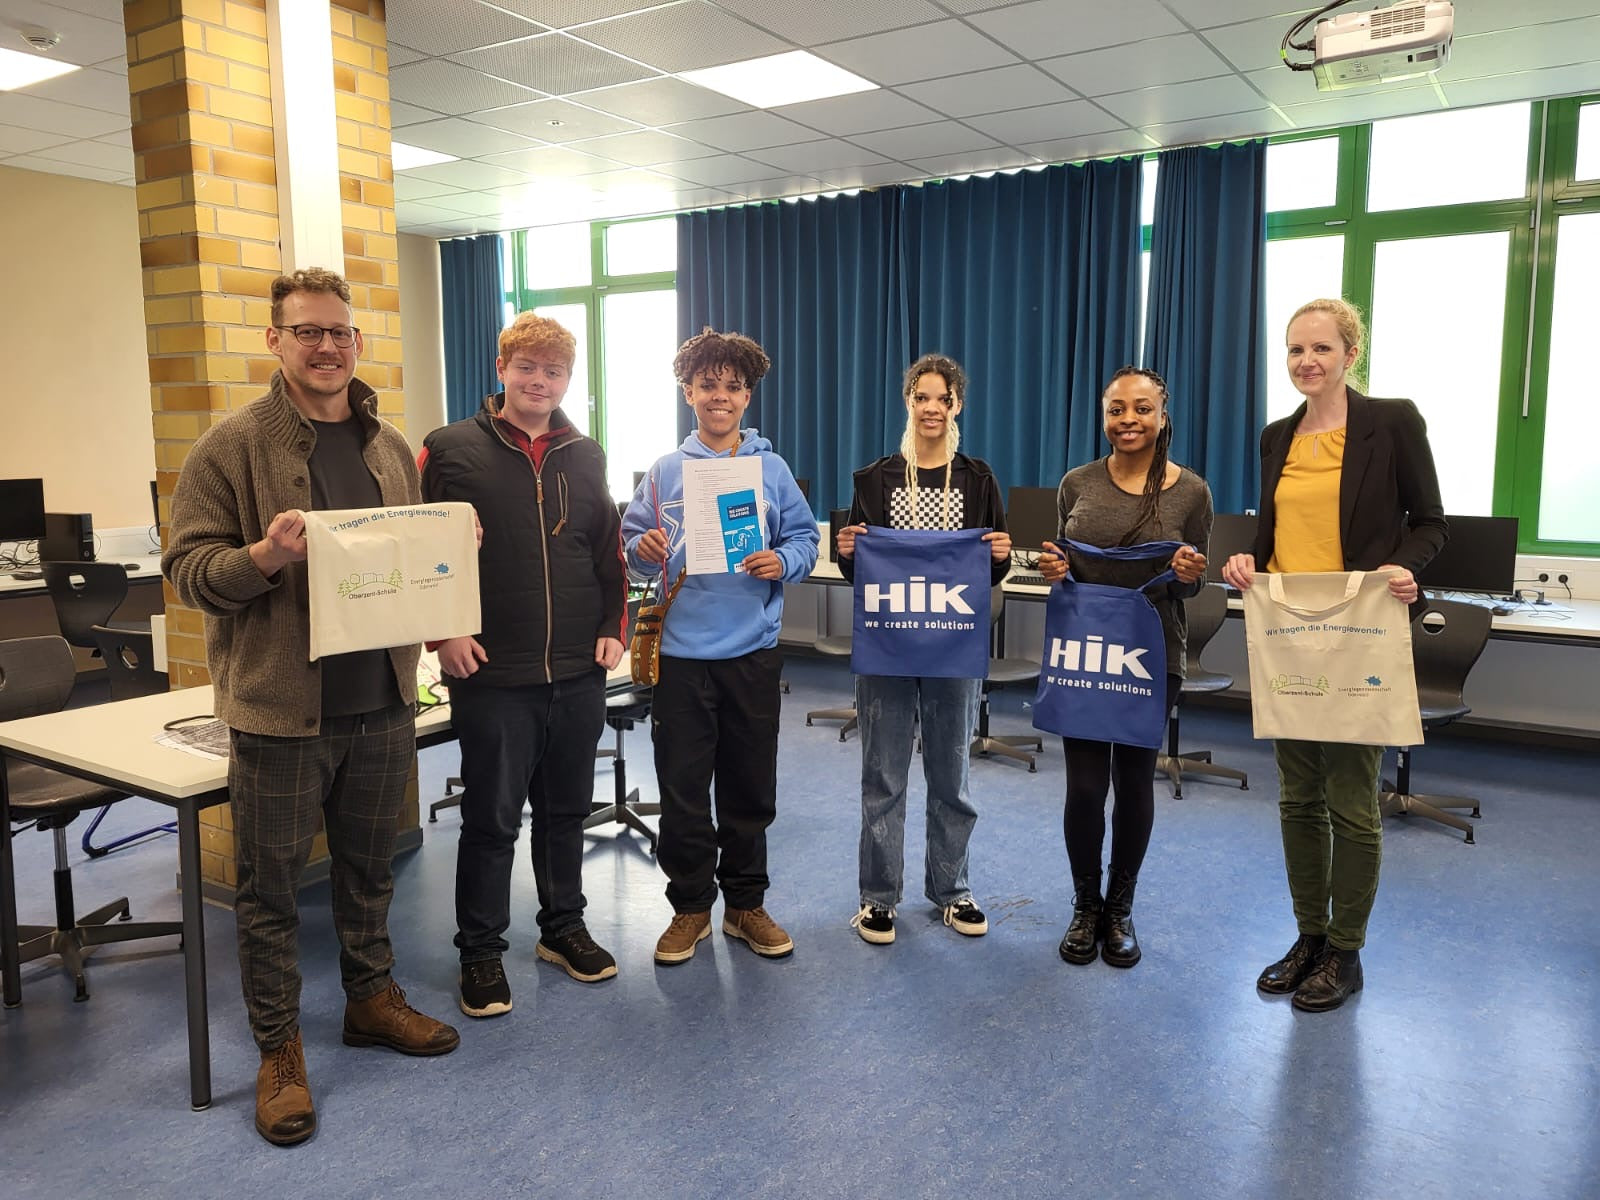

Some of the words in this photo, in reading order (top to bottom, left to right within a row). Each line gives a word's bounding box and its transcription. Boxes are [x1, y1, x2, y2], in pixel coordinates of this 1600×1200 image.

[339, 516, 369, 531] tragen
[371, 512, 386, 521] die
[387, 508, 450, 519] Energiewende!
[865, 620, 879, 628] we
[884, 620, 919, 629] create
[924, 620, 975, 630] solutions
[1265, 629, 1278, 637] Wir
[1279, 624, 1306, 635] tragen
[1308, 624, 1321, 632] die
[1323, 623, 1387, 636] Energiewende!
[1057, 678, 1092, 689] create
[1098, 681, 1152, 696] solutions
